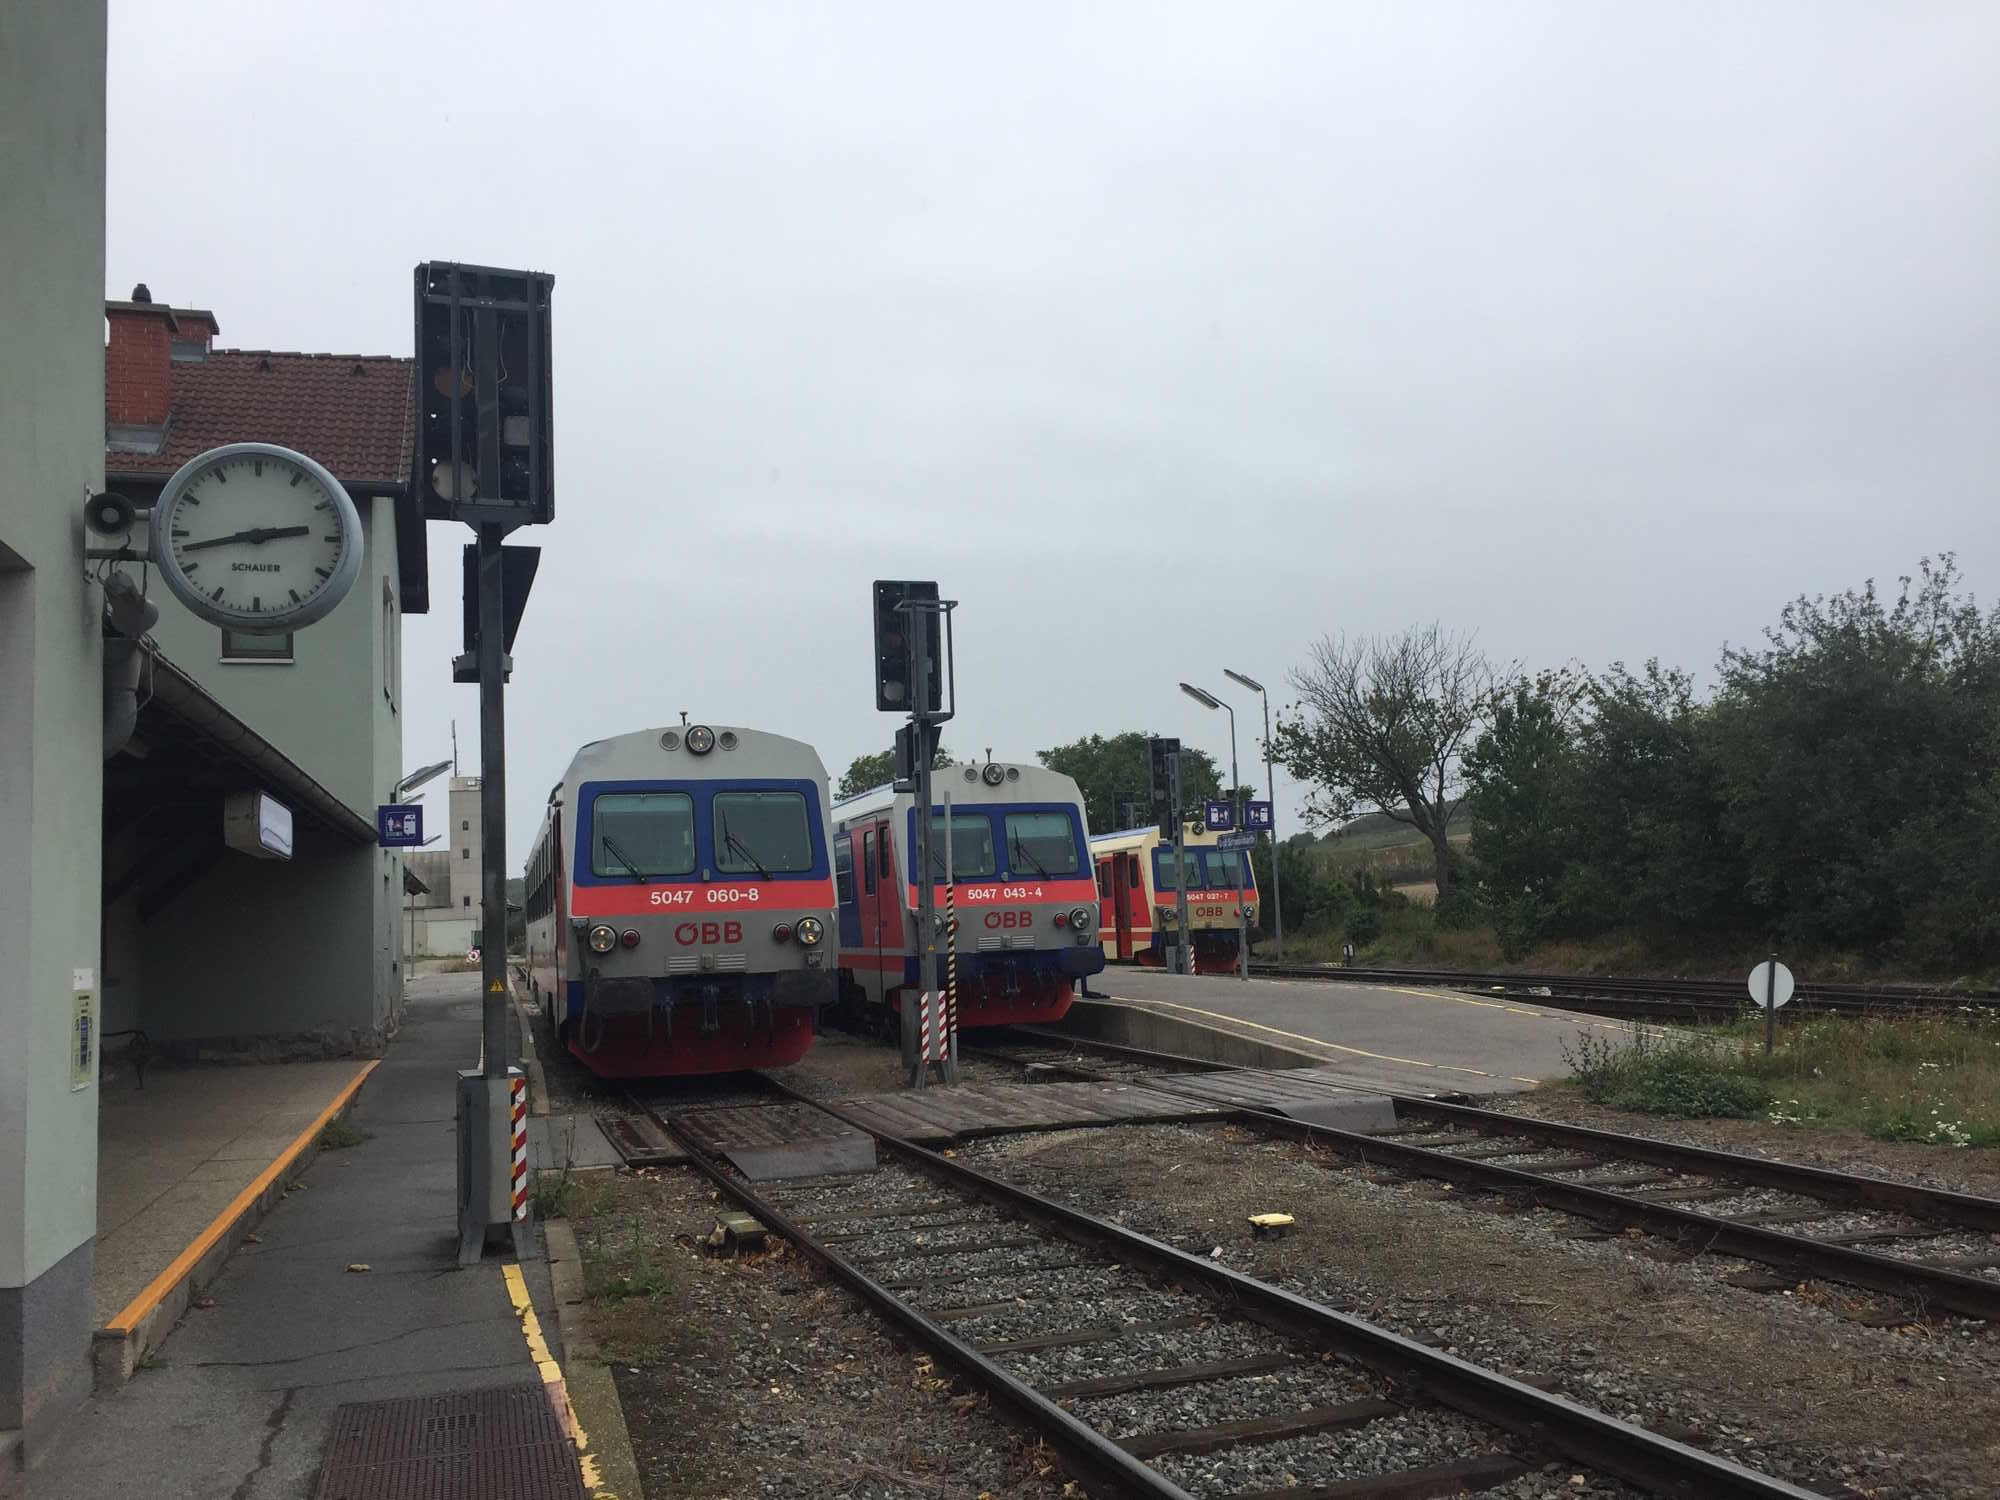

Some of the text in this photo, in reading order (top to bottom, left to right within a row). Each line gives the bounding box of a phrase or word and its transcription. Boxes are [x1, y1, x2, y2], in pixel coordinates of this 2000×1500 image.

[231, 562, 280, 573] SCHAUER
[650, 888, 760, 905] 5047 060-8
[967, 887, 1042, 900] 5047 043-4
